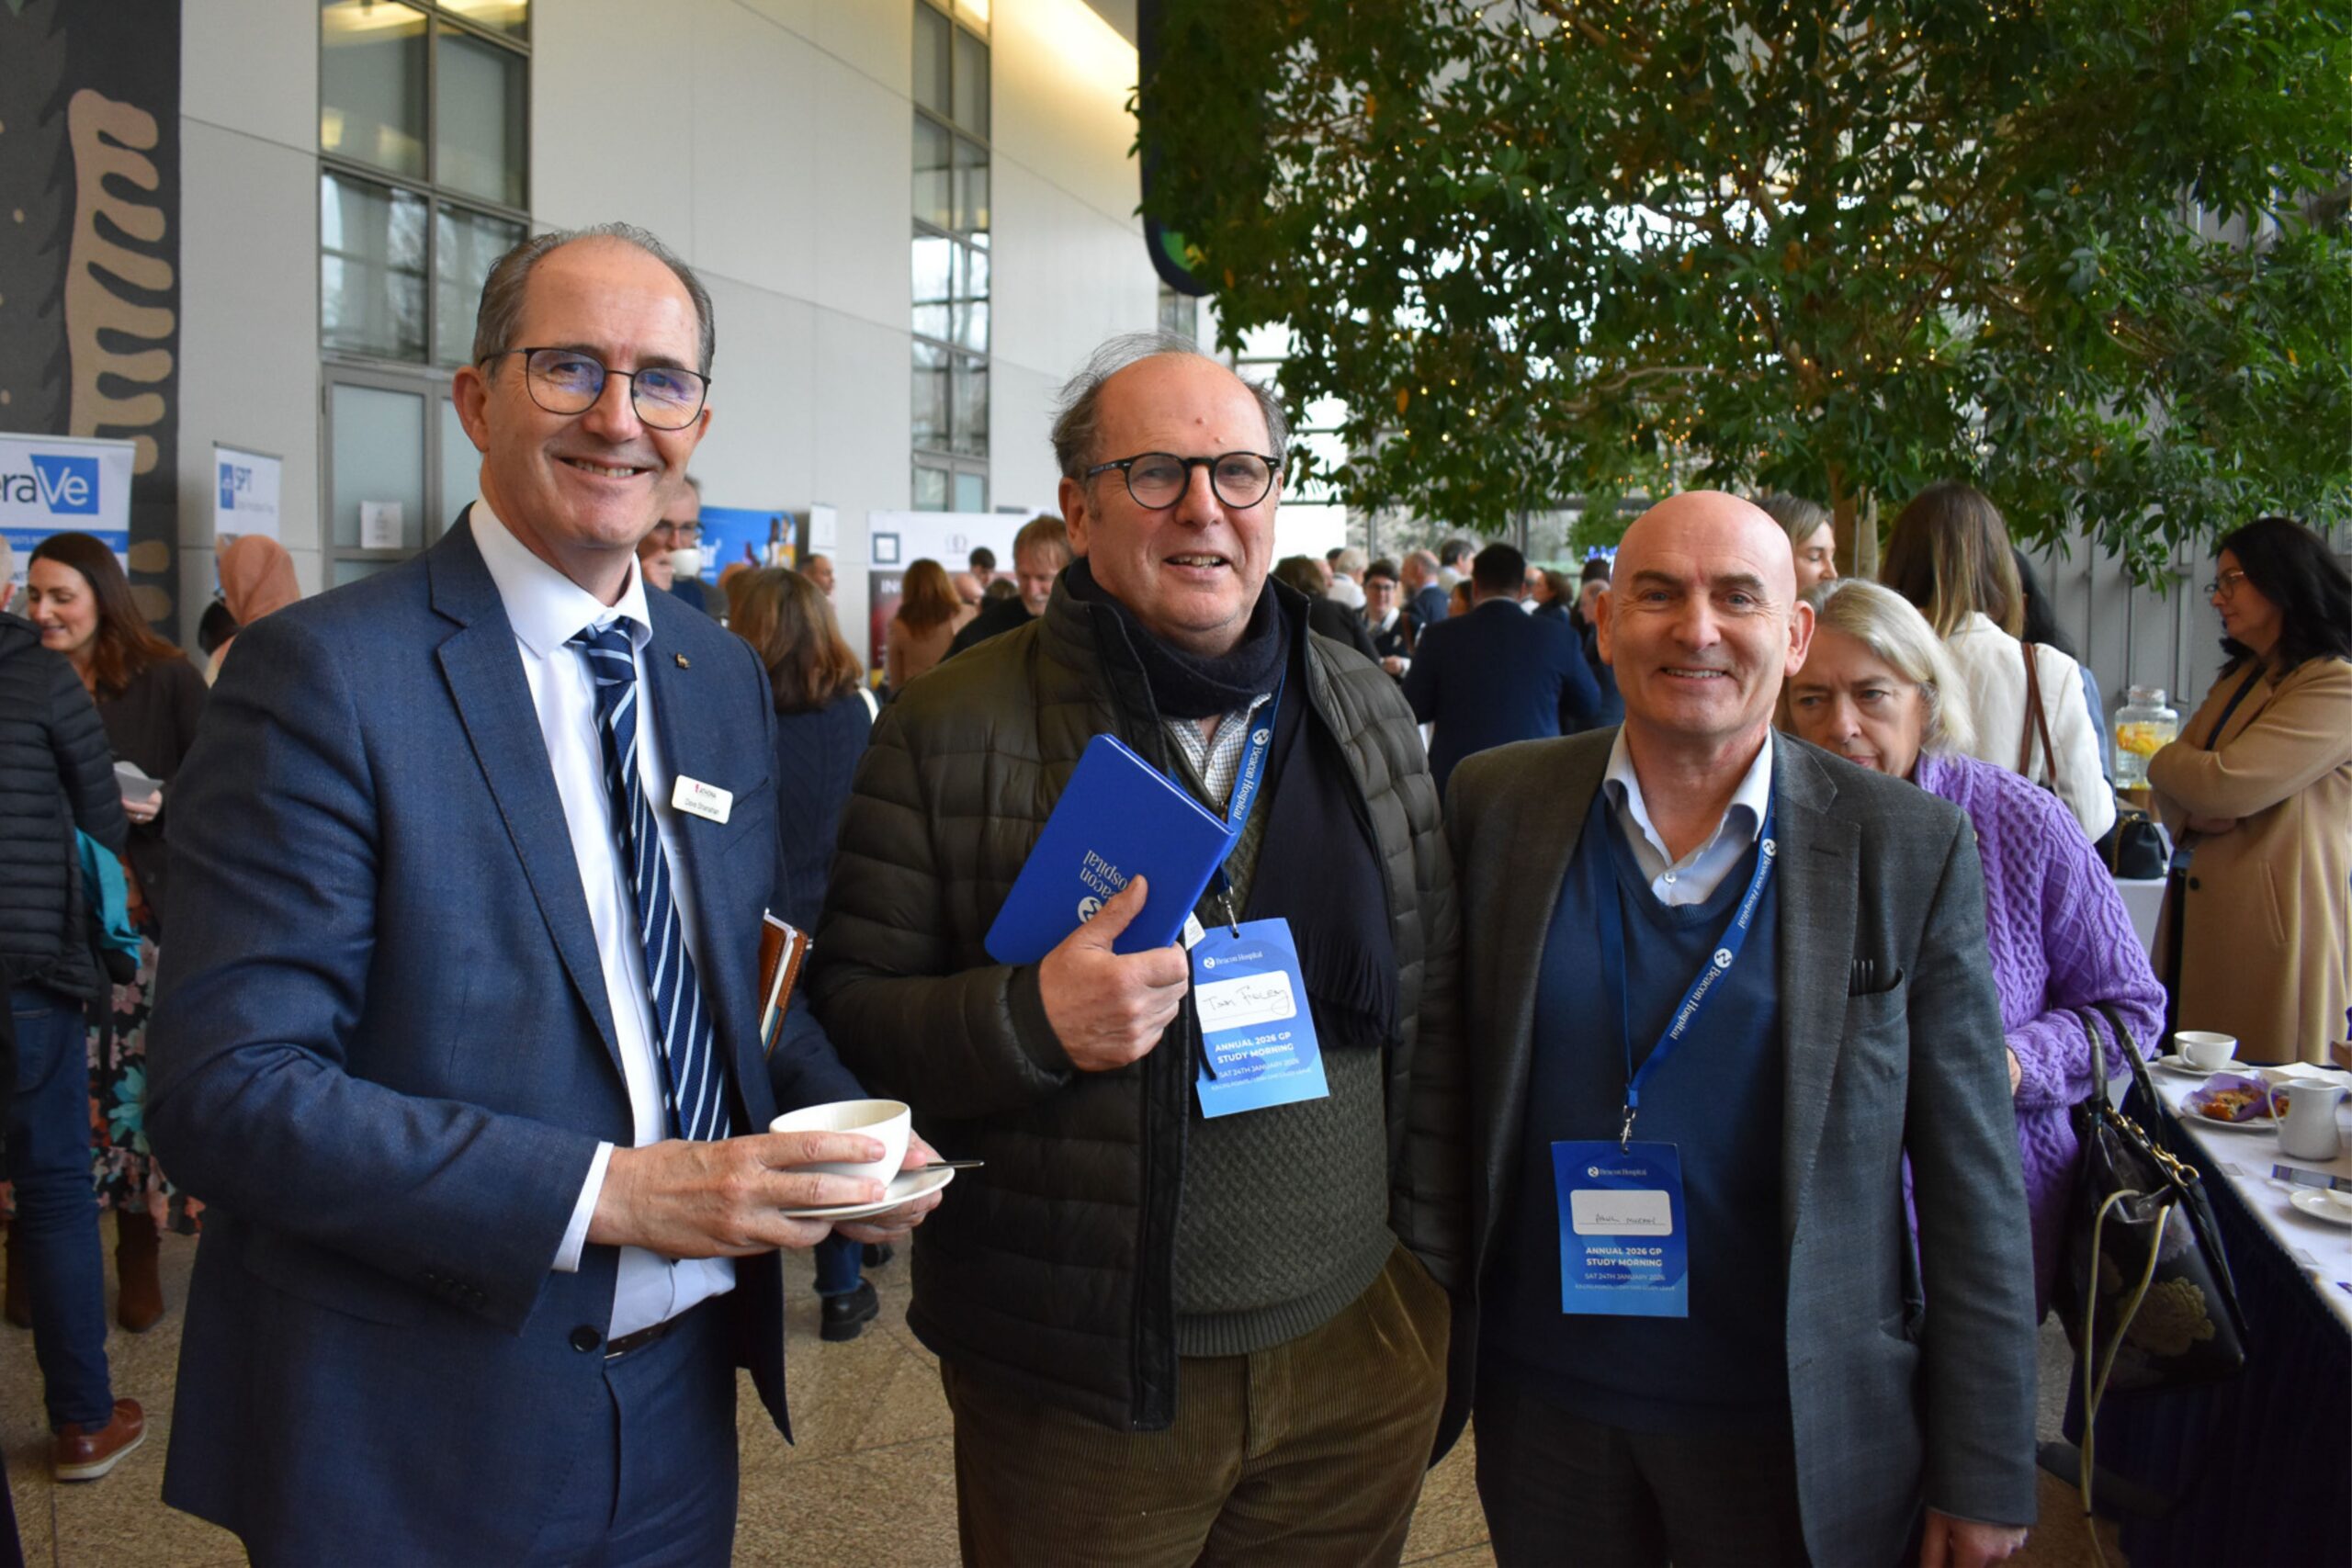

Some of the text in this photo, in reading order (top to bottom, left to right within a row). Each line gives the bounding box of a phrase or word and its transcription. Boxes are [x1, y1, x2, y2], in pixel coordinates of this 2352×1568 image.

[0, 466, 89, 506] raVe
[1233, 746, 1263, 820] Beacon Hospital
[1080, 866, 1115, 899] acon
[1082, 850, 1128, 891] ospital
[1737, 855, 1772, 929] Beacon Hospital
[1216, 951, 1264, 965] Beacon Hospital
[1669, 965, 1722, 1041] Beacon Hospital
[1215, 1031, 1292, 1053] ANNUAL 2026 GP
[1217, 1043, 1295, 1065] STUDY MORNING
[1586, 1258, 1662, 1267] STUDY MORNING
[1625, 1247, 1648, 1256] 2026
[1649, 1247, 1662, 1256] GP
